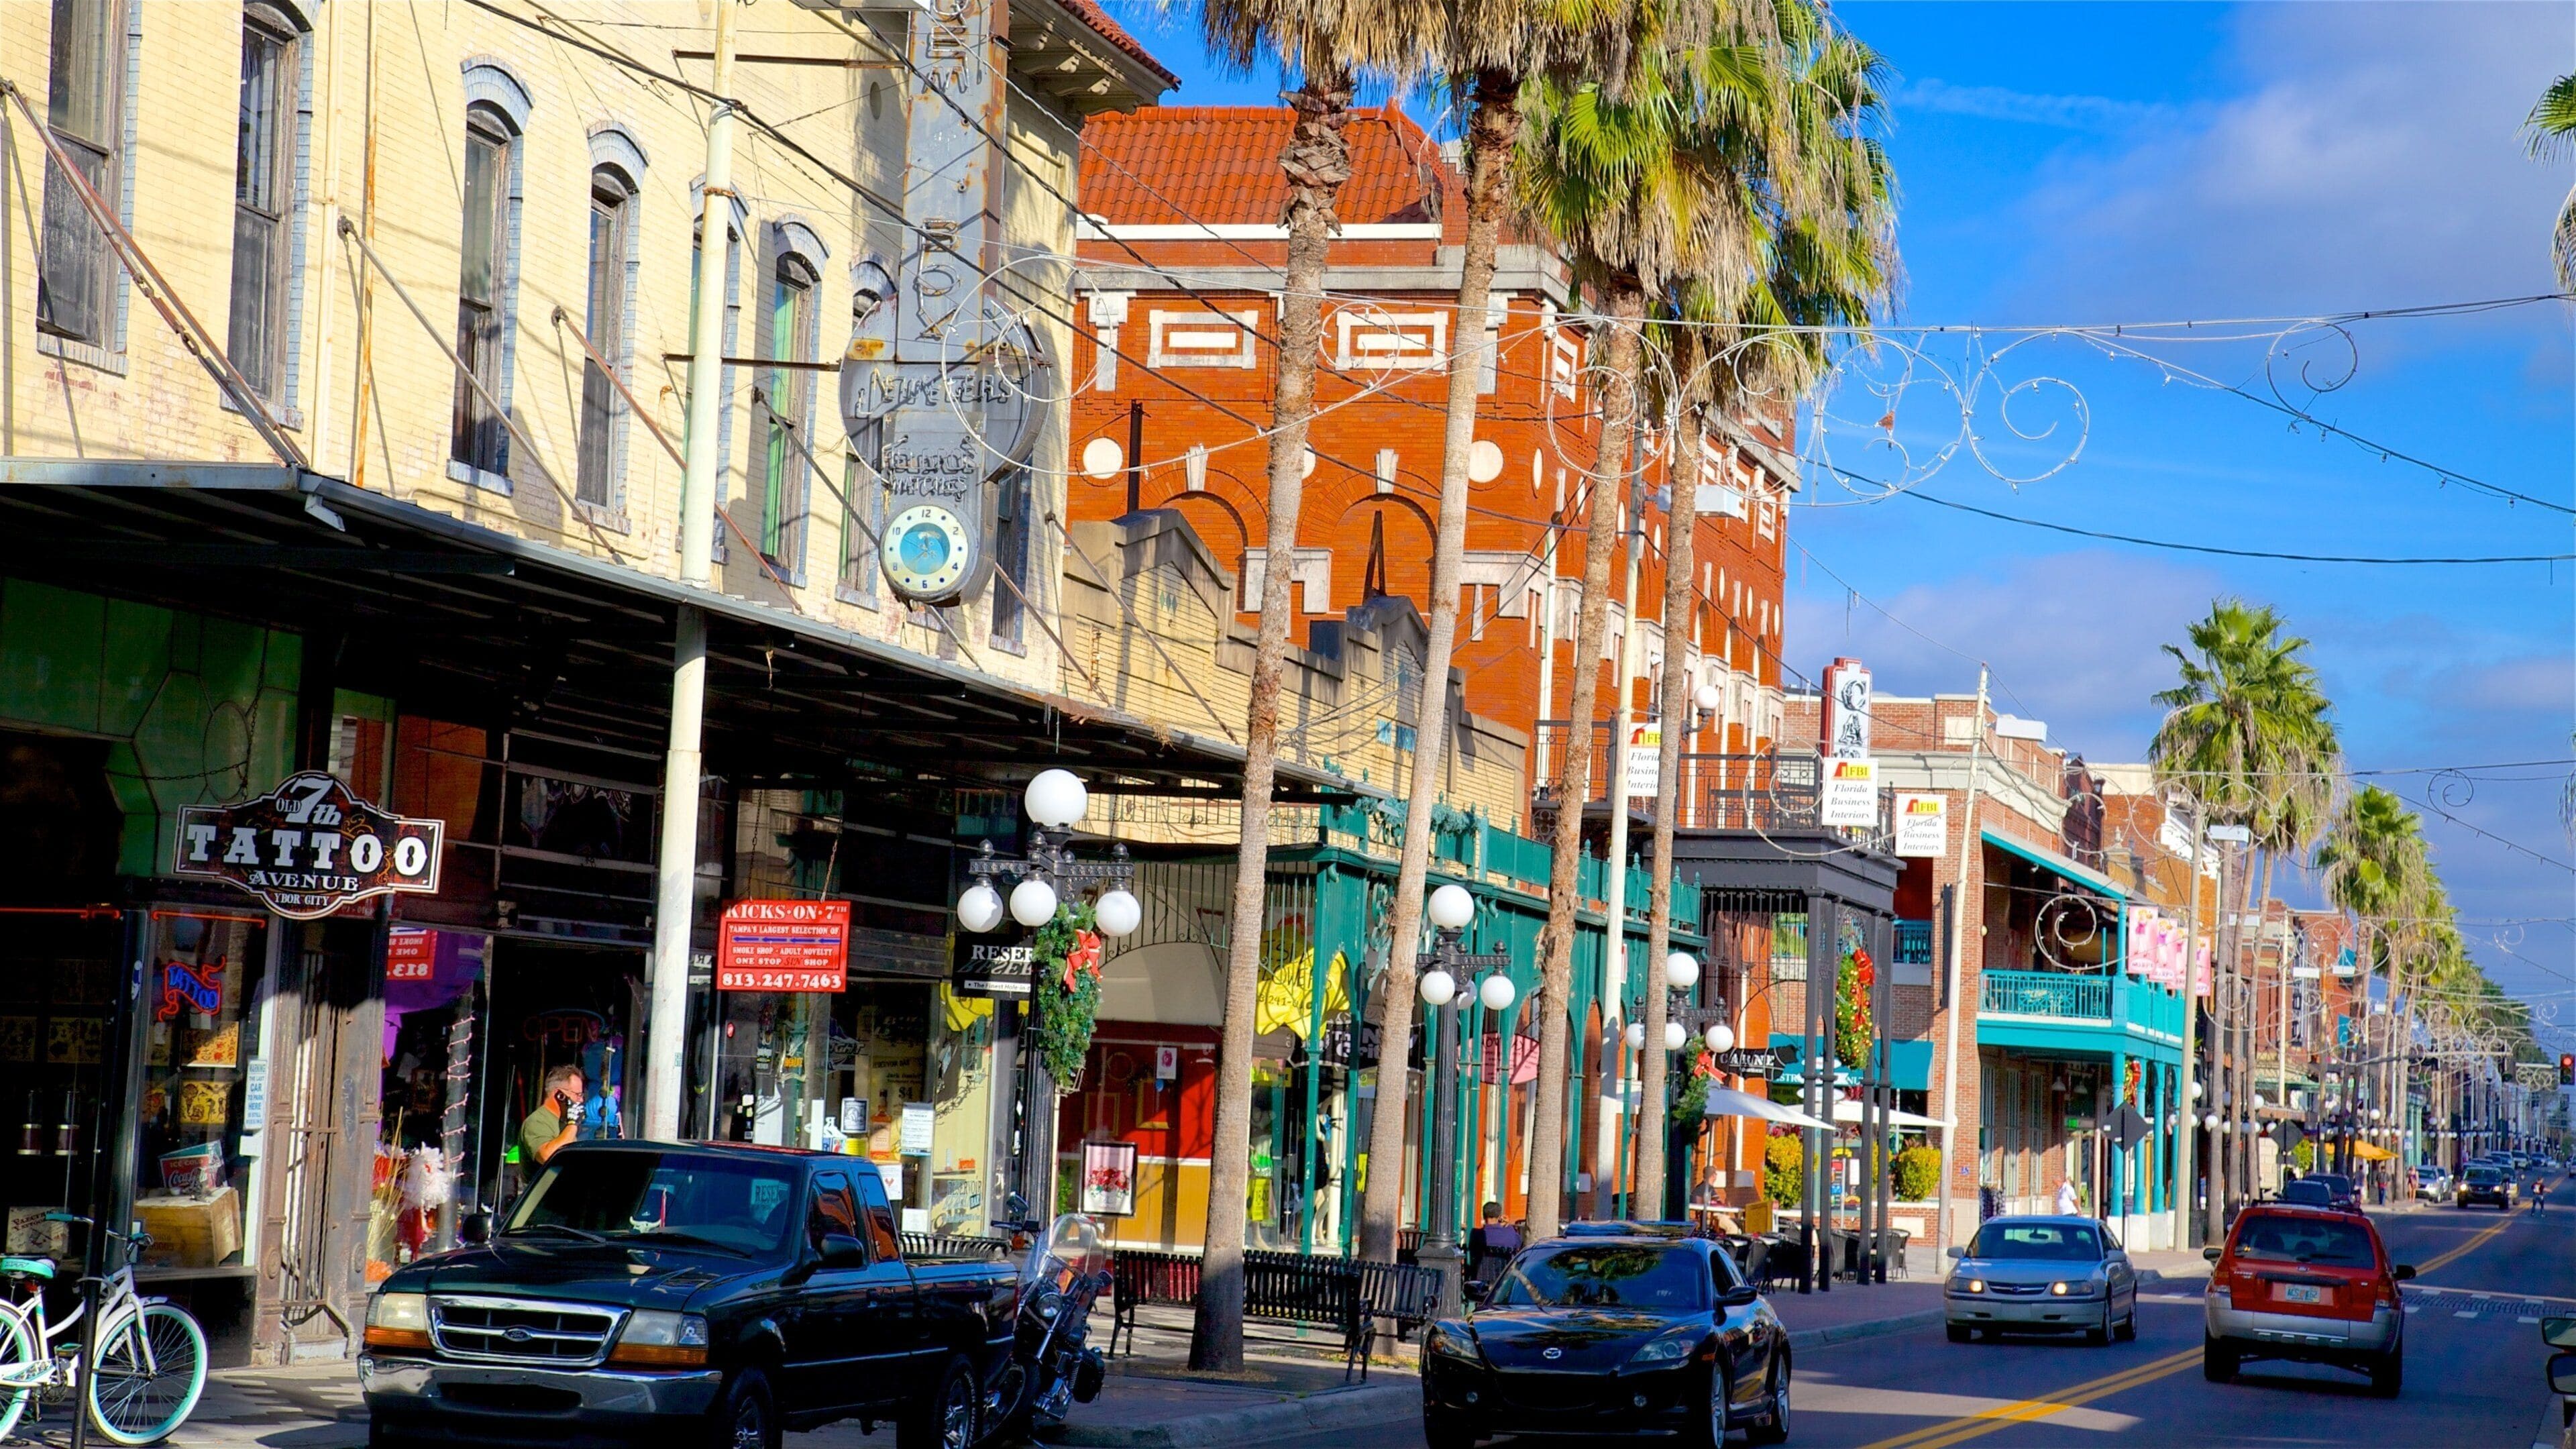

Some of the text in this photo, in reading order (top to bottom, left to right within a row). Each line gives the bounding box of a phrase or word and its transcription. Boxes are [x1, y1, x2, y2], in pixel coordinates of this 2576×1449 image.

[922, 509, 931, 518] 12
[892, 527, 900, 535] 10
[953, 527, 959, 535] 2
[952, 562, 959, 571] 4
[922, 580, 928, 589] 6
[1648, 733, 1662, 743] FB
[1631, 752, 1660, 761] Flori
[1628, 766, 1658, 775] Busin
[1850, 766, 1868, 776] FBI
[1835, 784, 1868, 793] Florida
[276, 797, 302, 814] OLD
[1831, 797, 1870, 806] Business
[1920, 802, 1938, 812] FBI
[1830, 810, 1870, 819] Interiors
[1907, 818, 1937, 827] Florida
[1903, 830, 1940, 839] Business
[186, 824, 429, 877] TATTOO
[1903, 843, 1939, 851] Interiors
[248, 871, 359, 892] AVENUE
[274, 893, 301, 906] YBOR
[304, 894, 331, 907] CITY
[729, 925, 757, 933] TAMPA'S
[792, 926, 828, 934] SELECTION
[803, 948, 833, 956] NOVELTY
[784, 957, 803, 966] SIN
[722, 973, 841, 989] 813.247.7463
[521, 1014, 599, 1043] OPEN
[1720, 1053, 1776, 1067] CARNE
[251, 1083, 262, 1092] CAR
